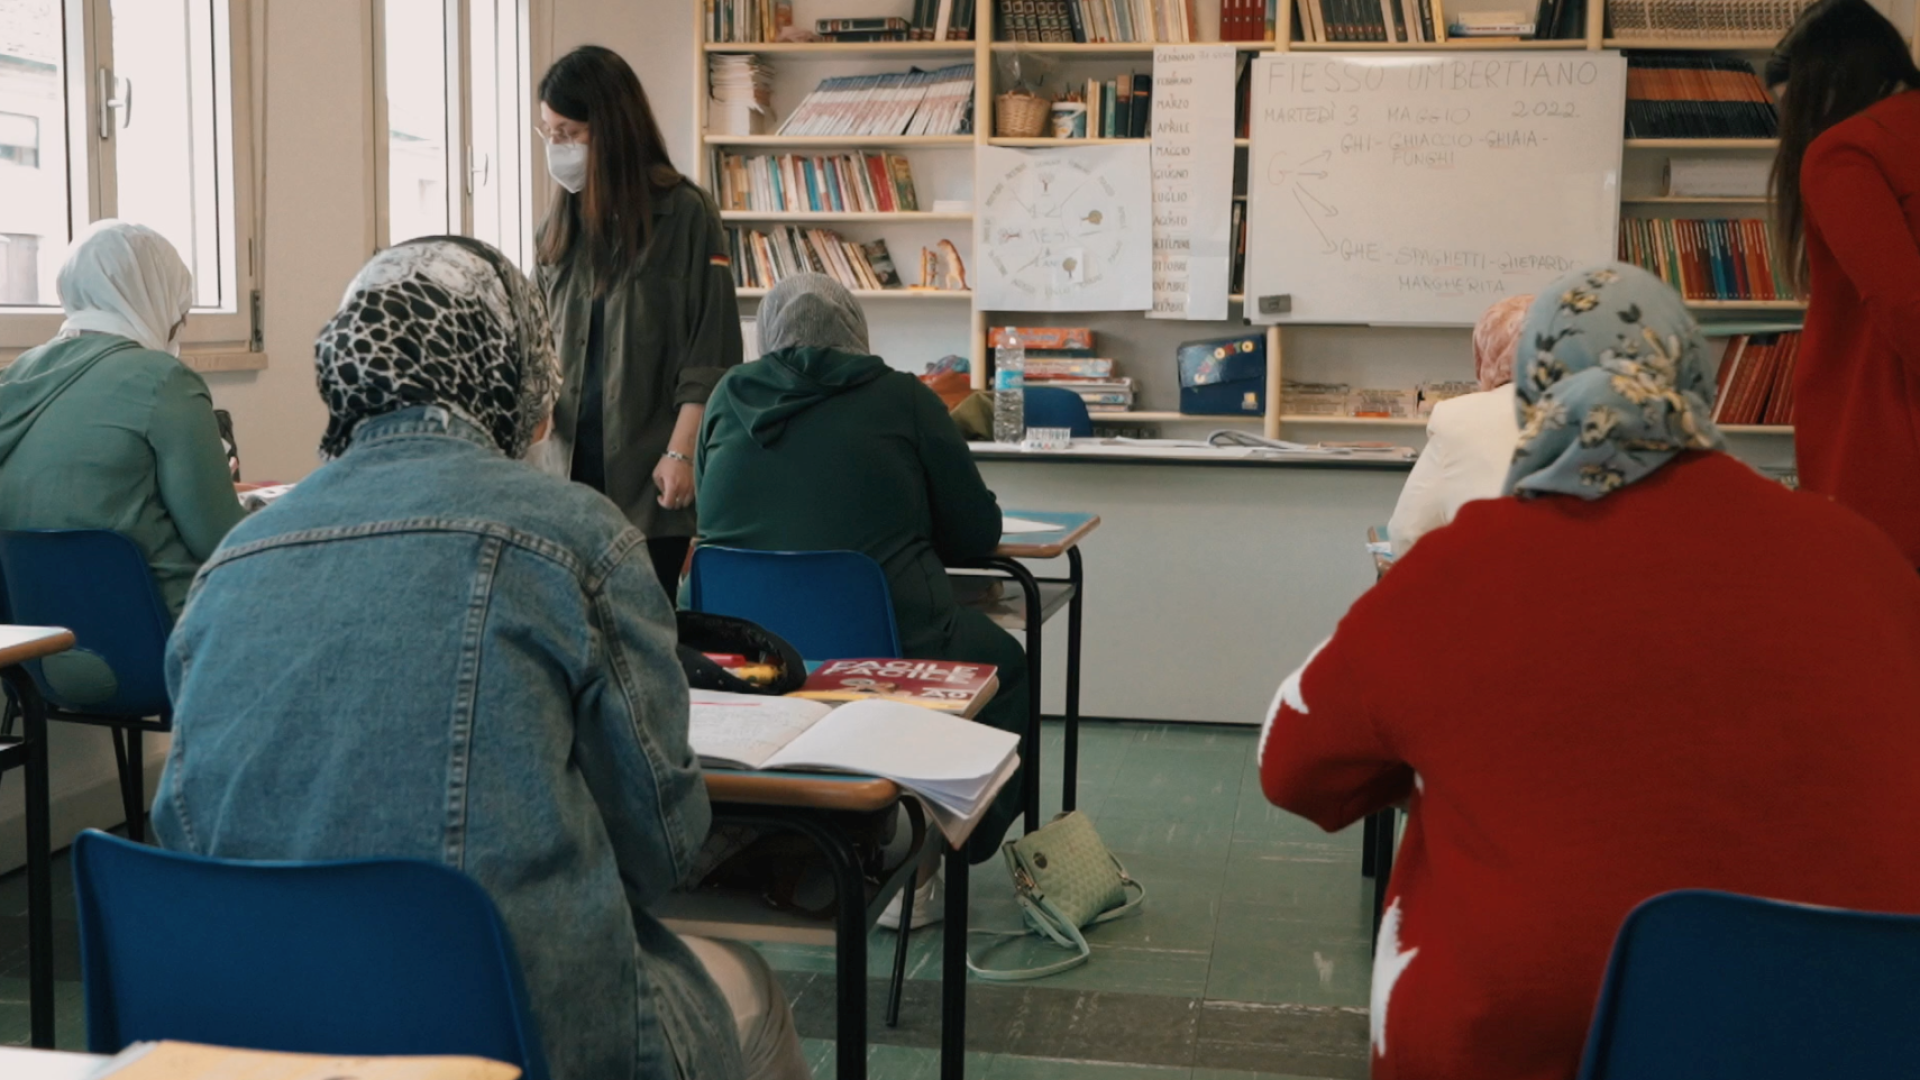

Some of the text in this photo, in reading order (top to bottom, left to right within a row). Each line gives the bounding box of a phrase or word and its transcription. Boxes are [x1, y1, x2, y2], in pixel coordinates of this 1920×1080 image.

[1268, 60, 1598, 93] FIESSO UMBERTIANO
[1156, 99, 1190, 110] MARZO
[1264, 101, 1336, 124] MARTEDÌ
[1343, 105, 1360, 127] 3
[1387, 106, 1471, 126] MAGGIO
[1392, 151, 1455, 168] FUNGHI
[1395, 246, 1486, 271] SPAGHETTI
[1398, 275, 1506, 295] MARGHERITA
[822, 667, 971, 685] FACILE
[830, 660, 979, 679] FACILE
